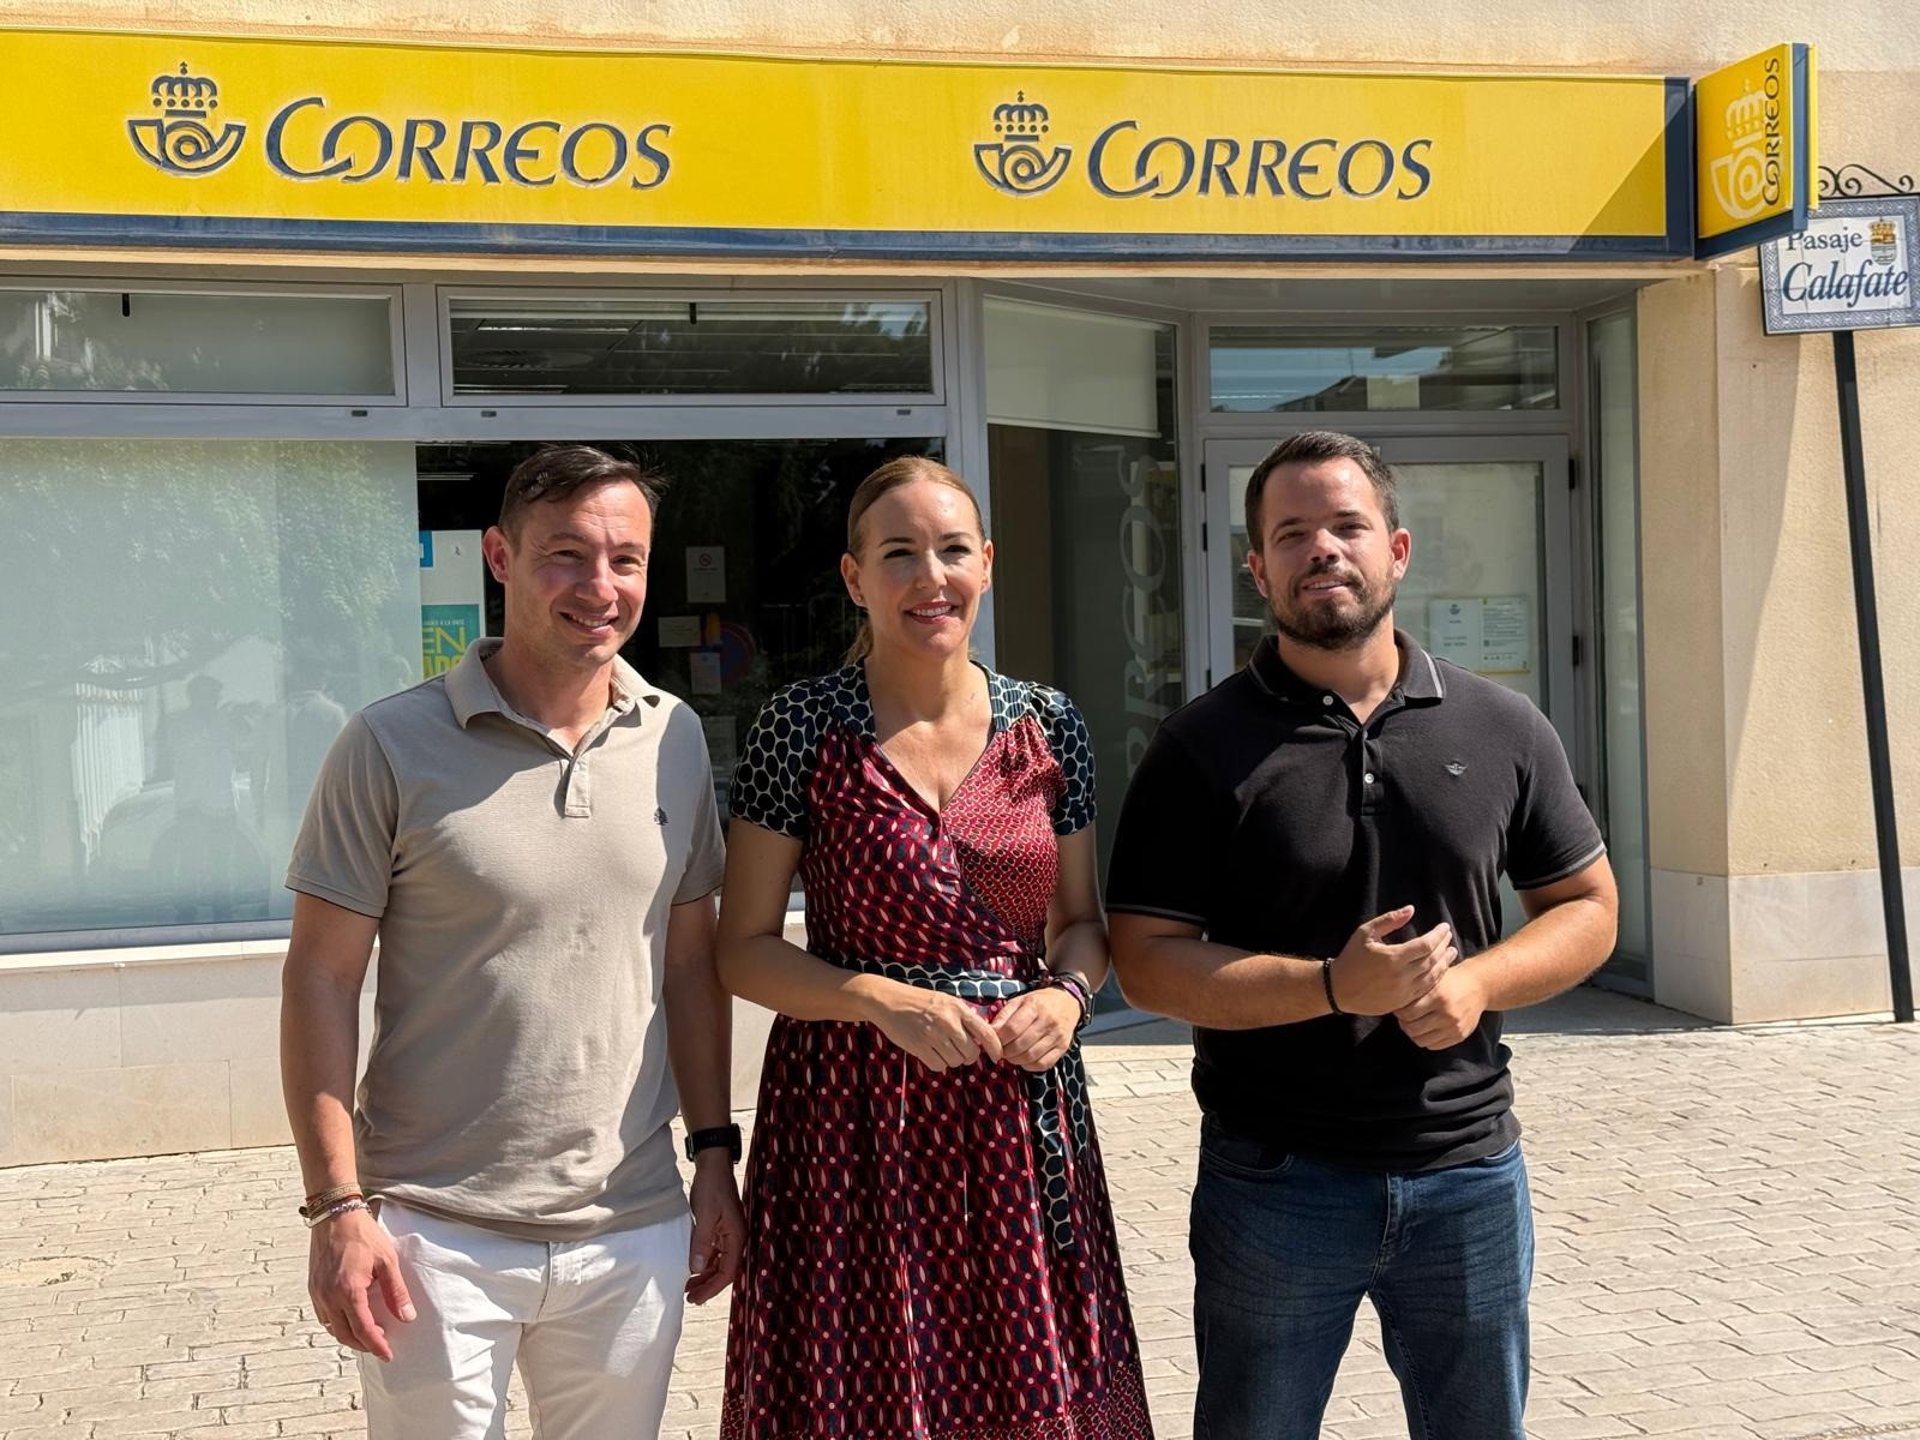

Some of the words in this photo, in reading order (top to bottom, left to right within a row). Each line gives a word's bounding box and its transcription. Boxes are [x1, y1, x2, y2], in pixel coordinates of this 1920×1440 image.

[265, 96, 673, 190] CORREOS
[1087, 120, 1433, 200] CORREOS
[1763, 57, 1780, 206] CORREOS
[1786, 226, 1863, 252] Pasaje
[1782, 258, 1909, 307] Calafate
